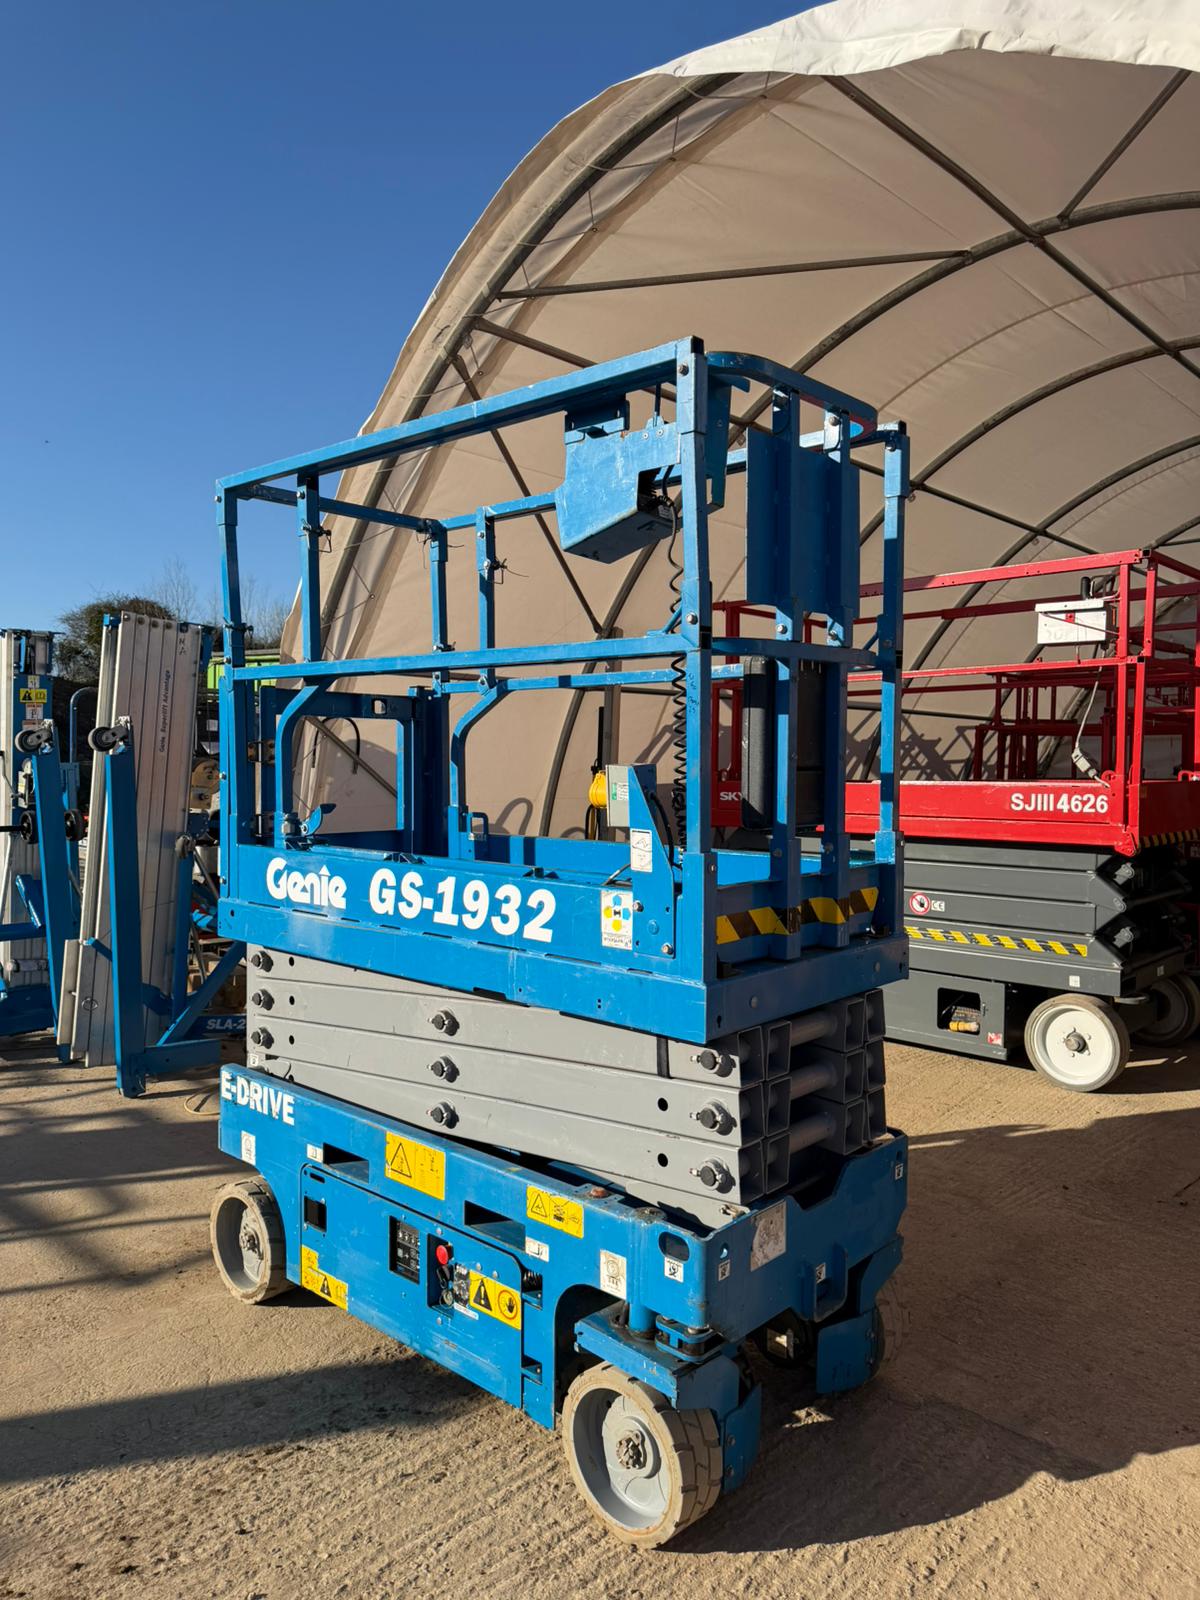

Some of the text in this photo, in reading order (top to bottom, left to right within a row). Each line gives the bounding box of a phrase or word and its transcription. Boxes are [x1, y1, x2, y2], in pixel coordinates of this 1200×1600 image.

[162, 670, 171, 704] Advantage
[266, 857, 556, 943] Genie GS-1932
[221, 1070, 295, 1126] E-DRIVE
